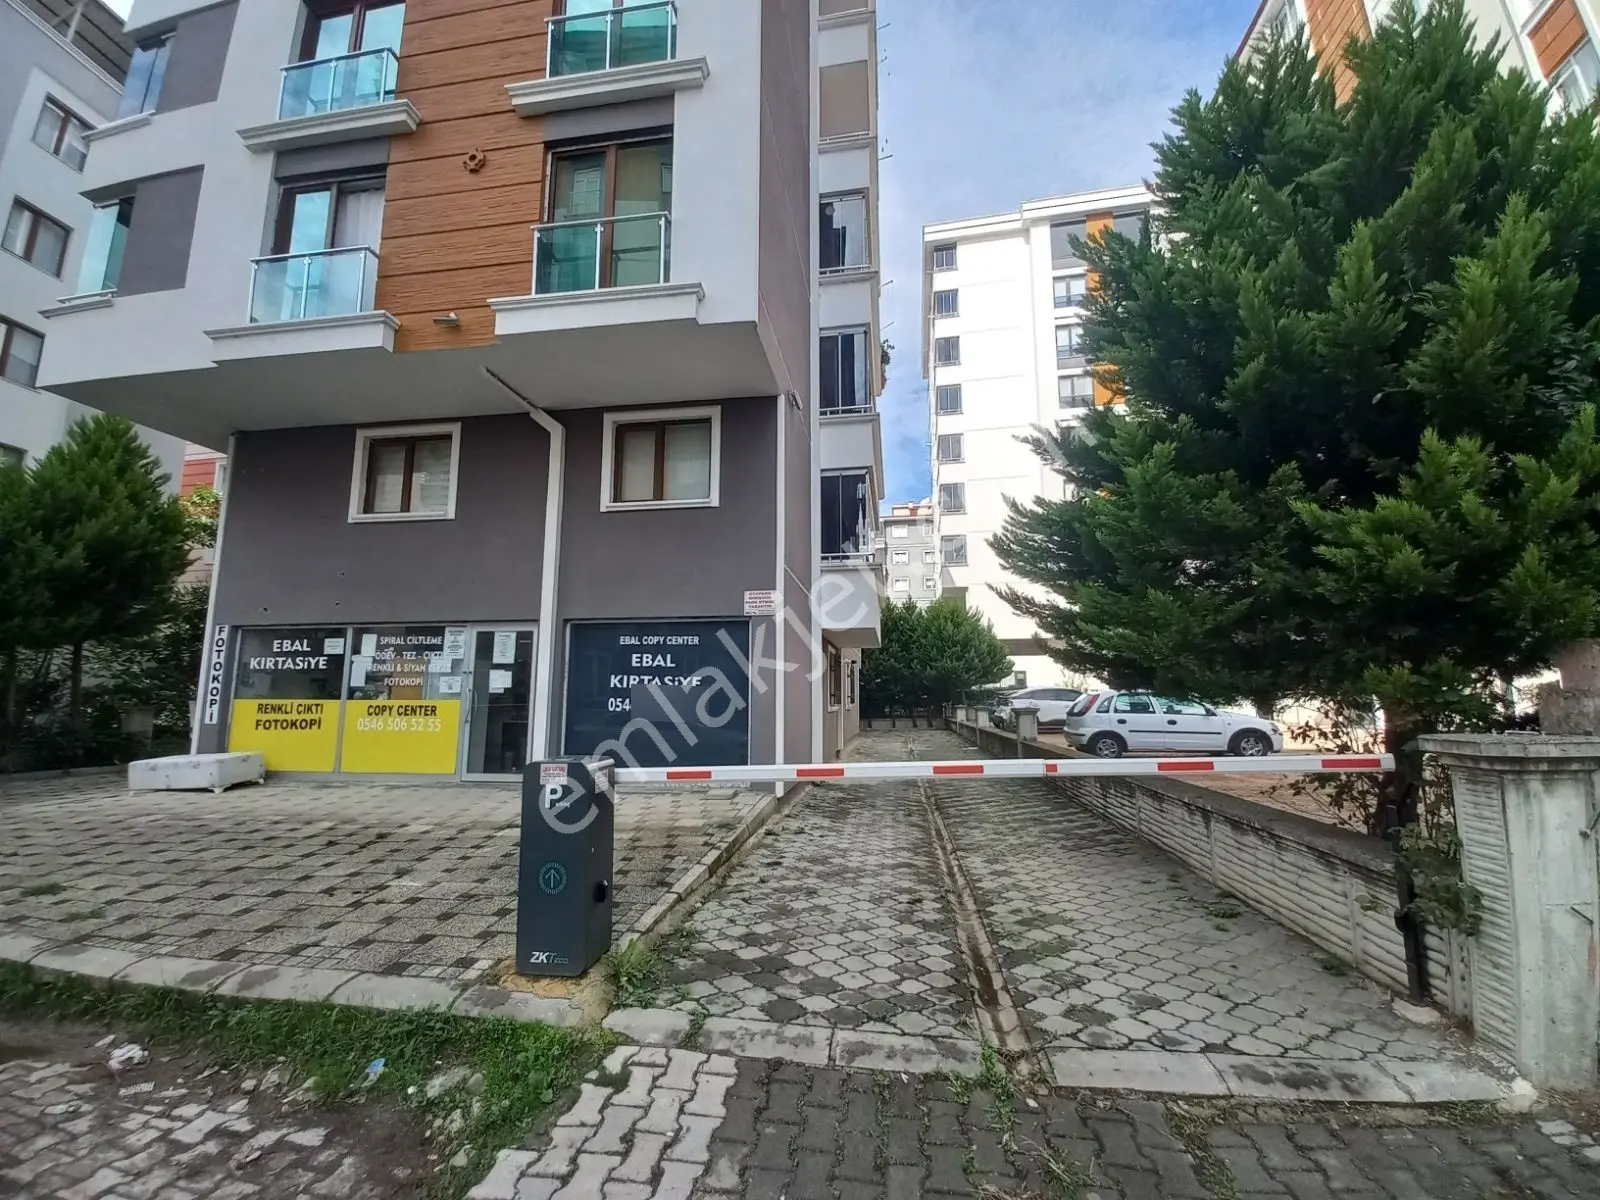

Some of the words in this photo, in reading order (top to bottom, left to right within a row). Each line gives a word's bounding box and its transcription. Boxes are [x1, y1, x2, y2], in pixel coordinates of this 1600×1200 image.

[272, 639, 312, 653] EBAL
[380, 634, 405, 645] SPİRAL
[407, 634, 443, 645] CİLTLEME
[619, 636, 641, 645] EBAL
[642, 636, 665, 645] COPY
[666, 636, 700, 646] CENTER
[402, 651, 417, 660] TEZ
[631, 653, 676, 667] EBAL
[256, 702, 294, 715] RENKLİ
[367, 705, 394, 716] COPY
[397, 705, 437, 716] CENTER
[608, 697, 632, 711] 054
[255, 717, 322, 731] FOTOKOPİ
[357, 719, 383, 731] 0546
[388, 719, 408, 731] 506
[427, 720, 441, 732] 55
